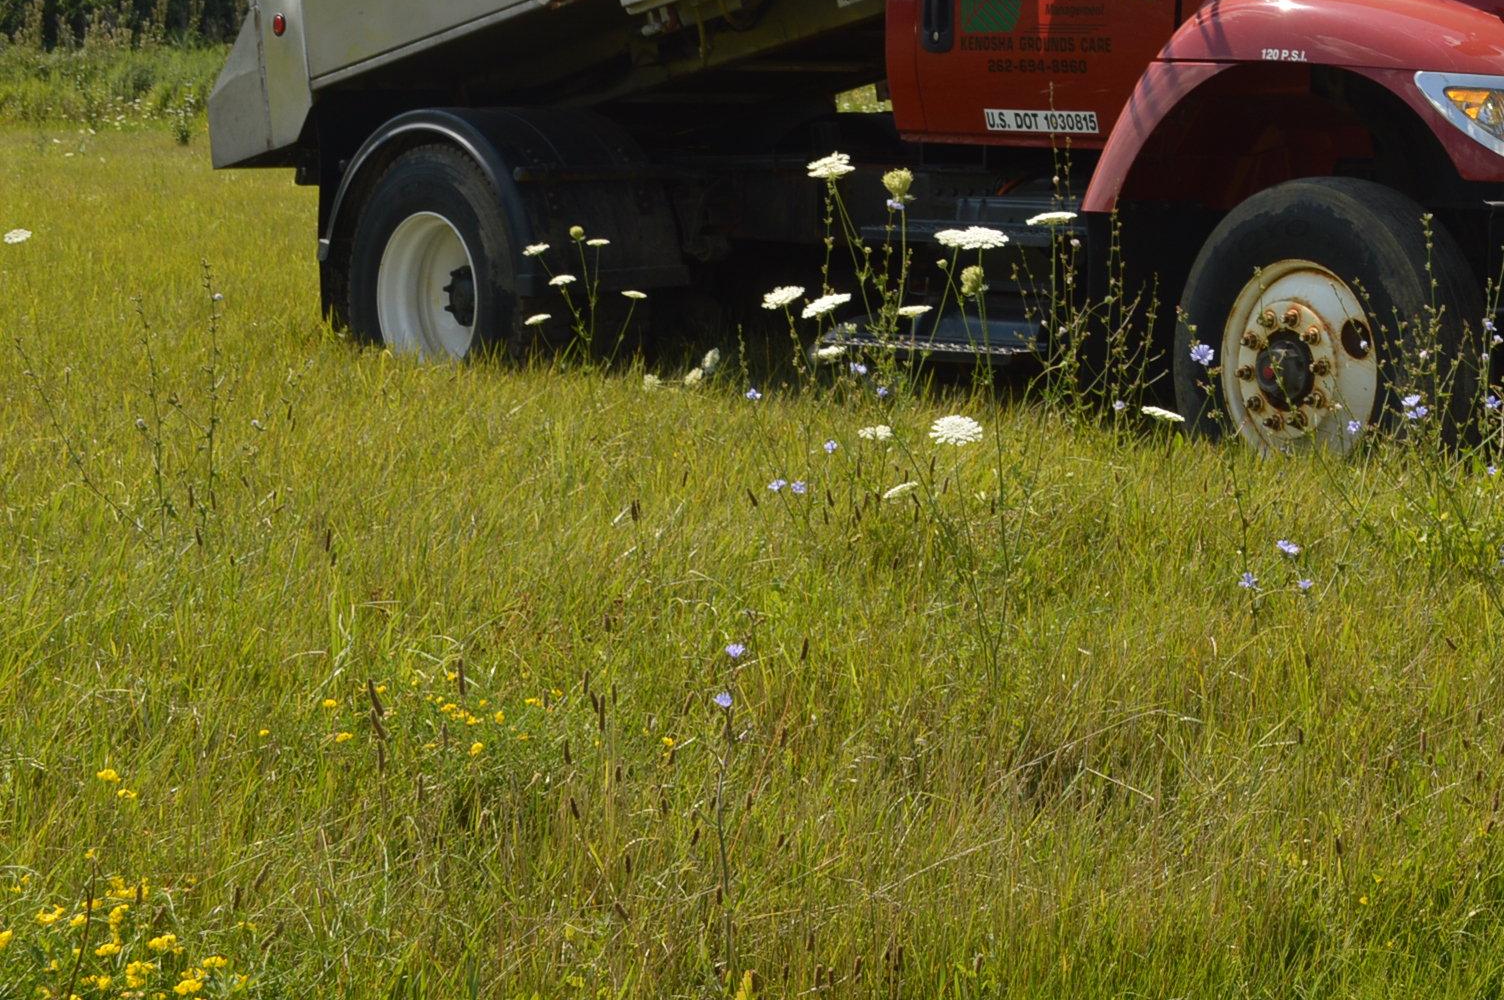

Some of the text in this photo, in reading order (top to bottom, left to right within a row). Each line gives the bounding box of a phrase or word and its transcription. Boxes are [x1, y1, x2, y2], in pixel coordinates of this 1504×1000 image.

[1045, 3, 1105, 18] Management
[960, 36, 1112, 53] KENOSHA GROUNDS CARE
[1261, 48, 1307, 62] 120 P.S.I.
[986, 111, 1097, 131] U.S. DOT 1030815
